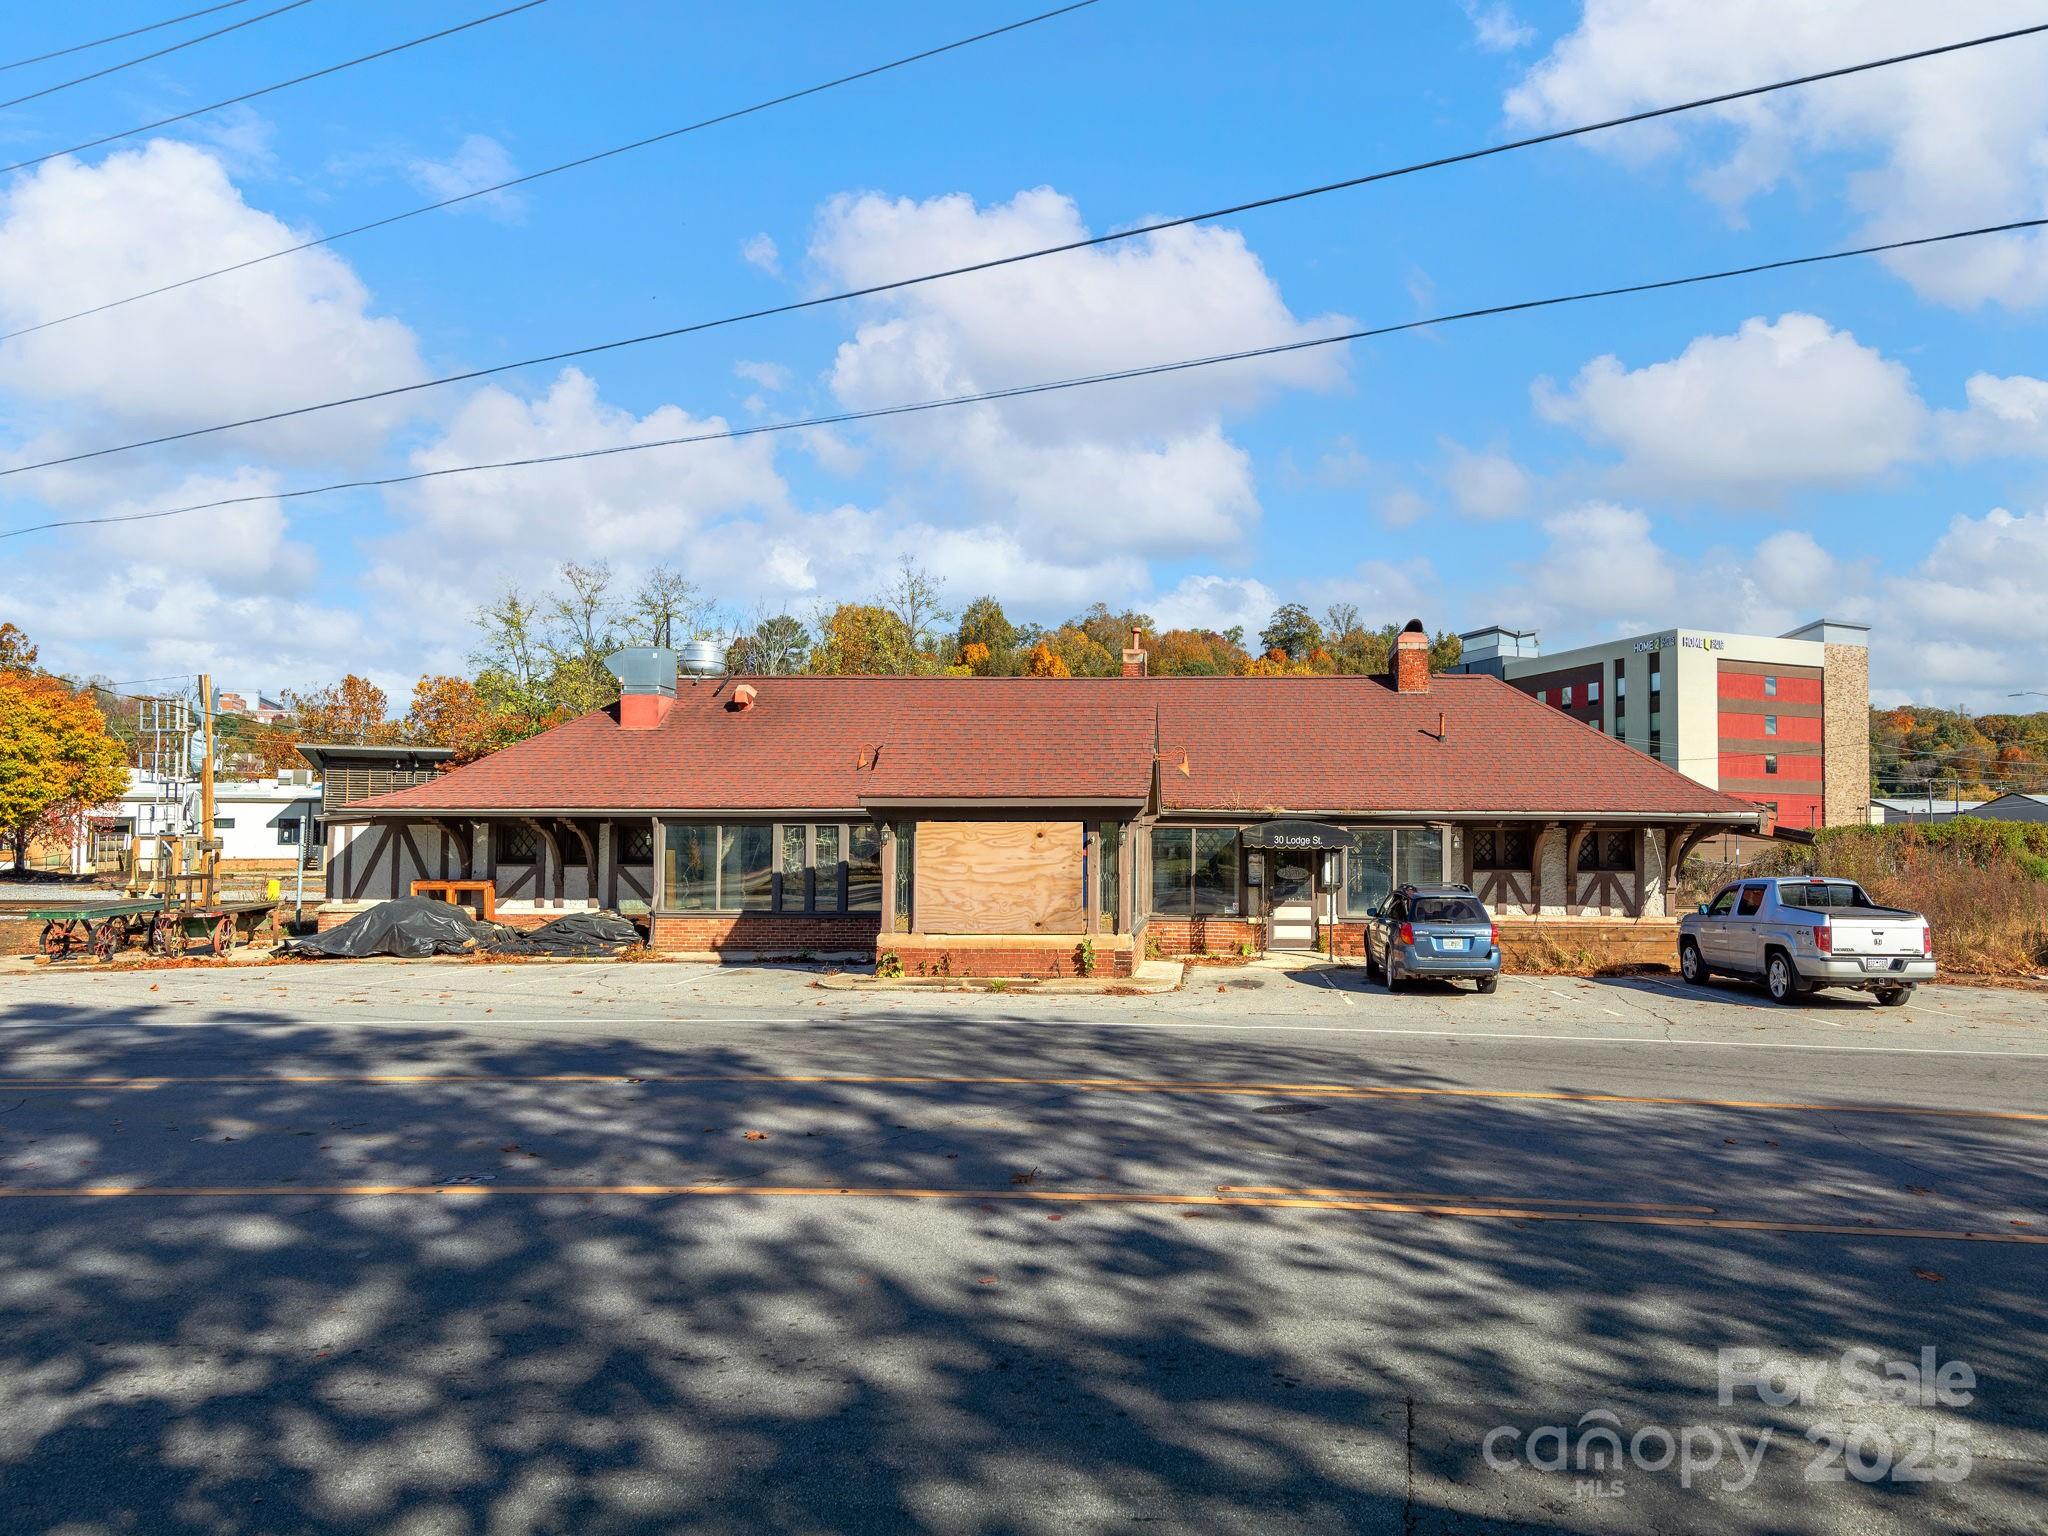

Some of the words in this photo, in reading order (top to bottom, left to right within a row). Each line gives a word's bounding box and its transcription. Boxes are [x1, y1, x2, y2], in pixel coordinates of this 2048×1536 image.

[1273, 835, 1284, 845] 30
[1285, 836, 1311, 847] Lodge
[1312, 835, 1323, 845] St.
